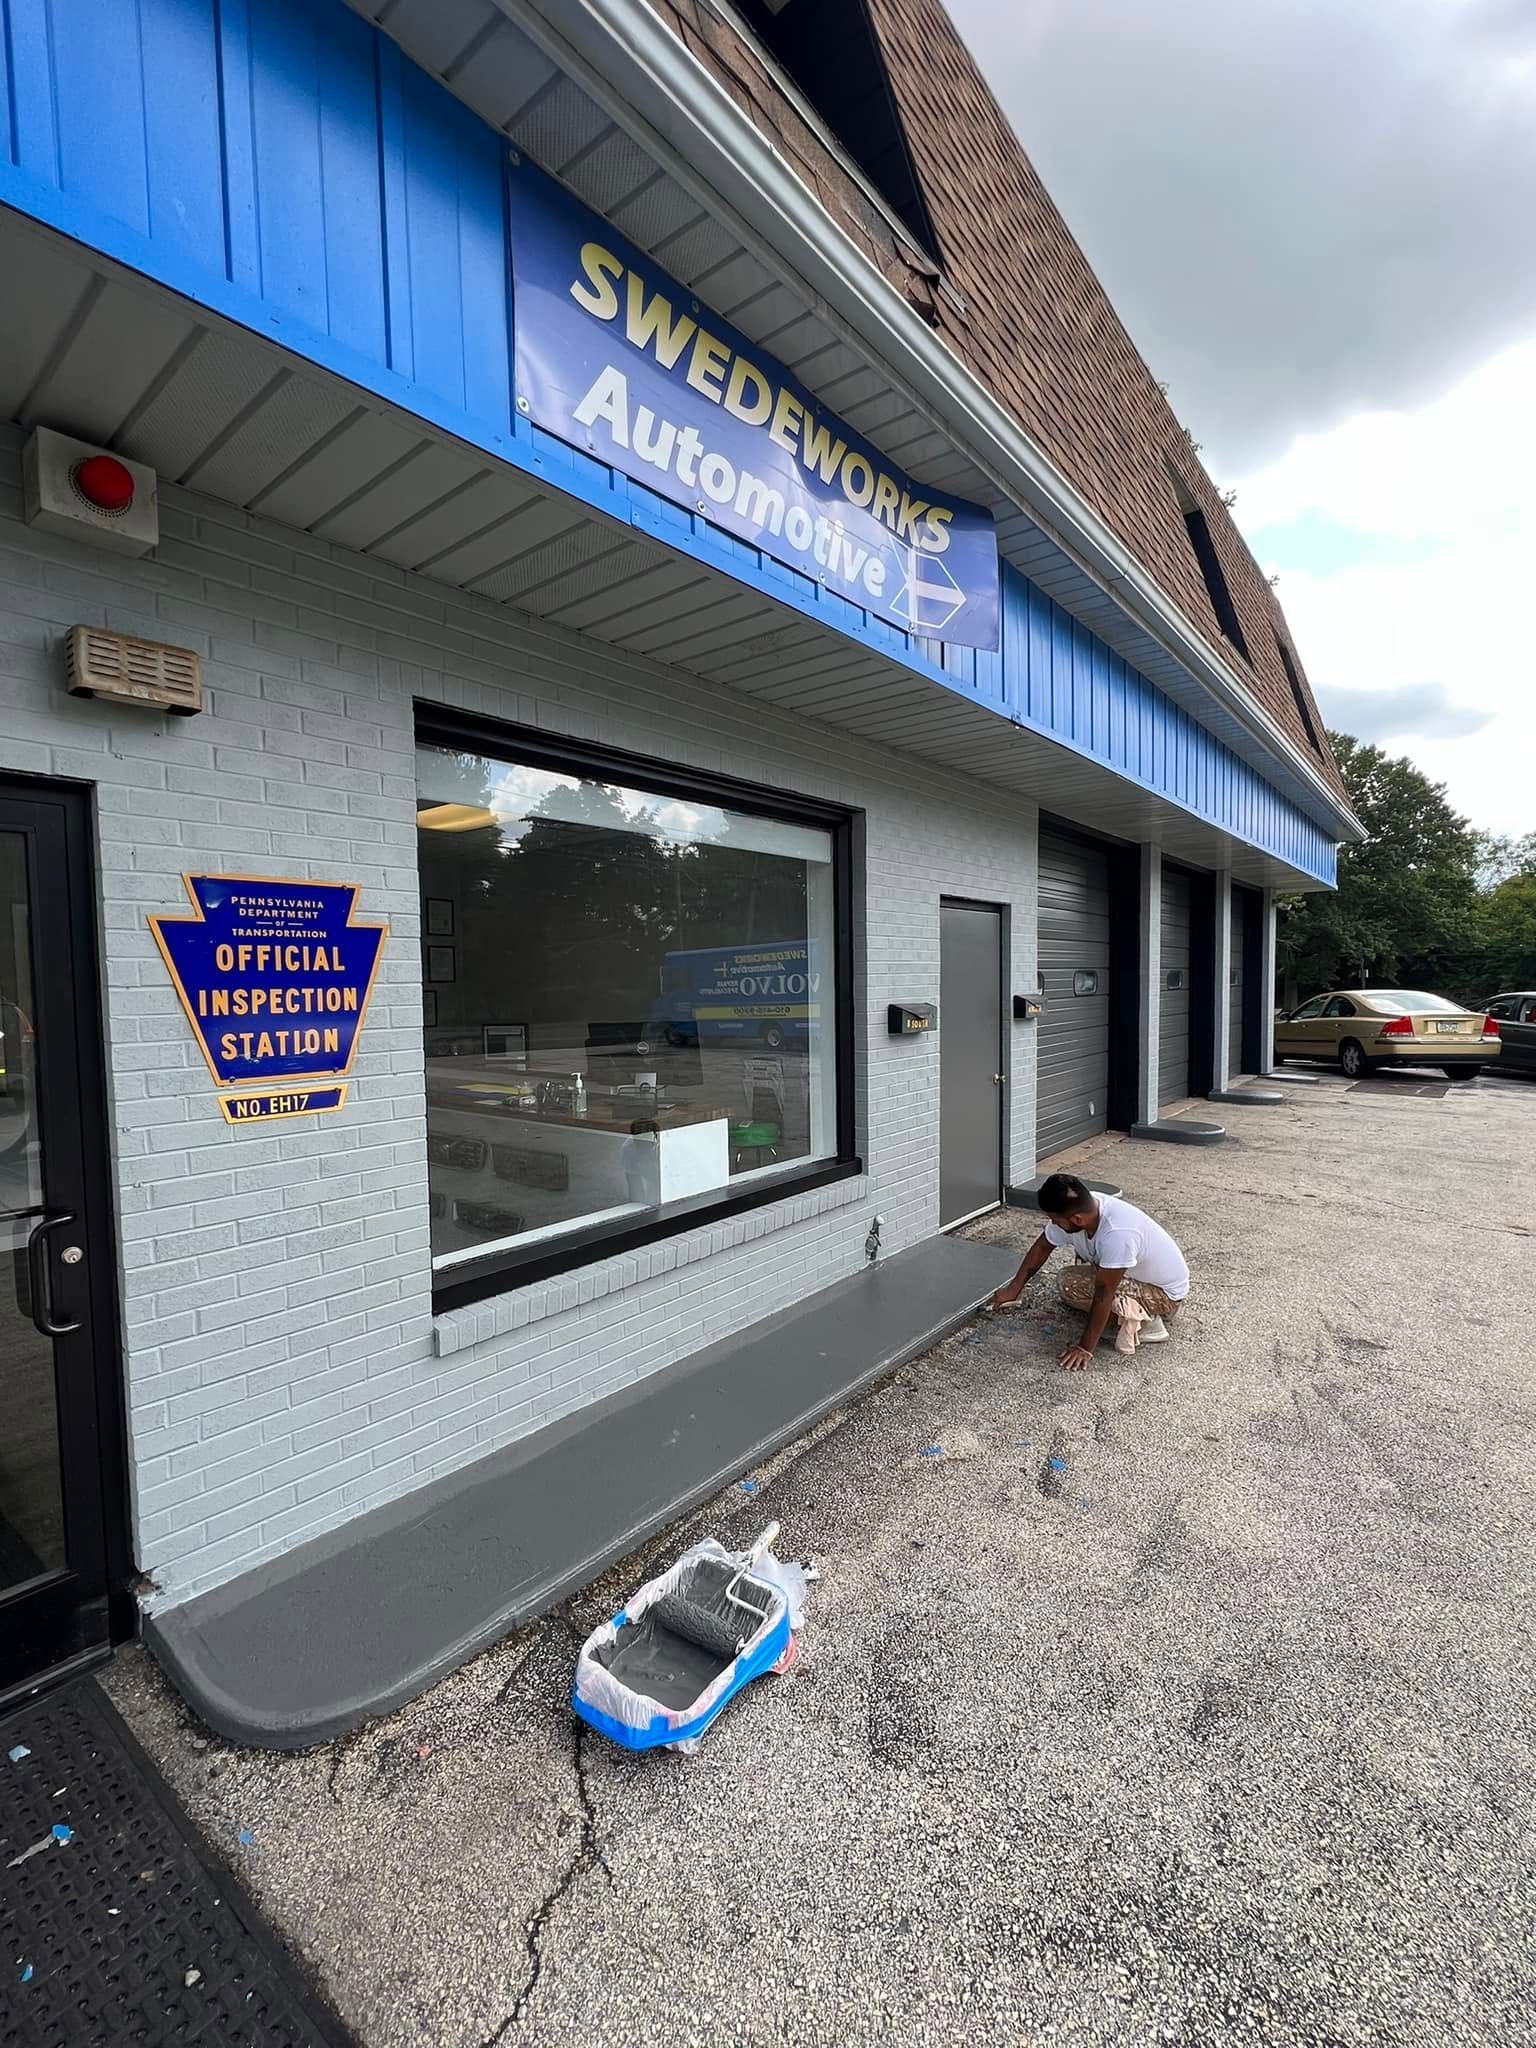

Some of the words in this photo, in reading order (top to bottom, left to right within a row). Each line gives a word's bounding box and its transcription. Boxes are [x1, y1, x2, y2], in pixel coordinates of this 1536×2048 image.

[569, 242, 955, 554] SWEDEWORKS
[572, 364, 888, 597] Automotive
[231, 896, 324, 909] PENNSYLVANIA
[239, 908, 319, 919] DEPARTMENT
[231, 928, 327, 939] TRANSPORTATION
[215, 943, 345, 972] OFFICIAL
[199, 987, 358, 1017] INSPECTION
[221, 1028, 338, 1061] STATION
[270, 1094, 310, 1113] EH17
